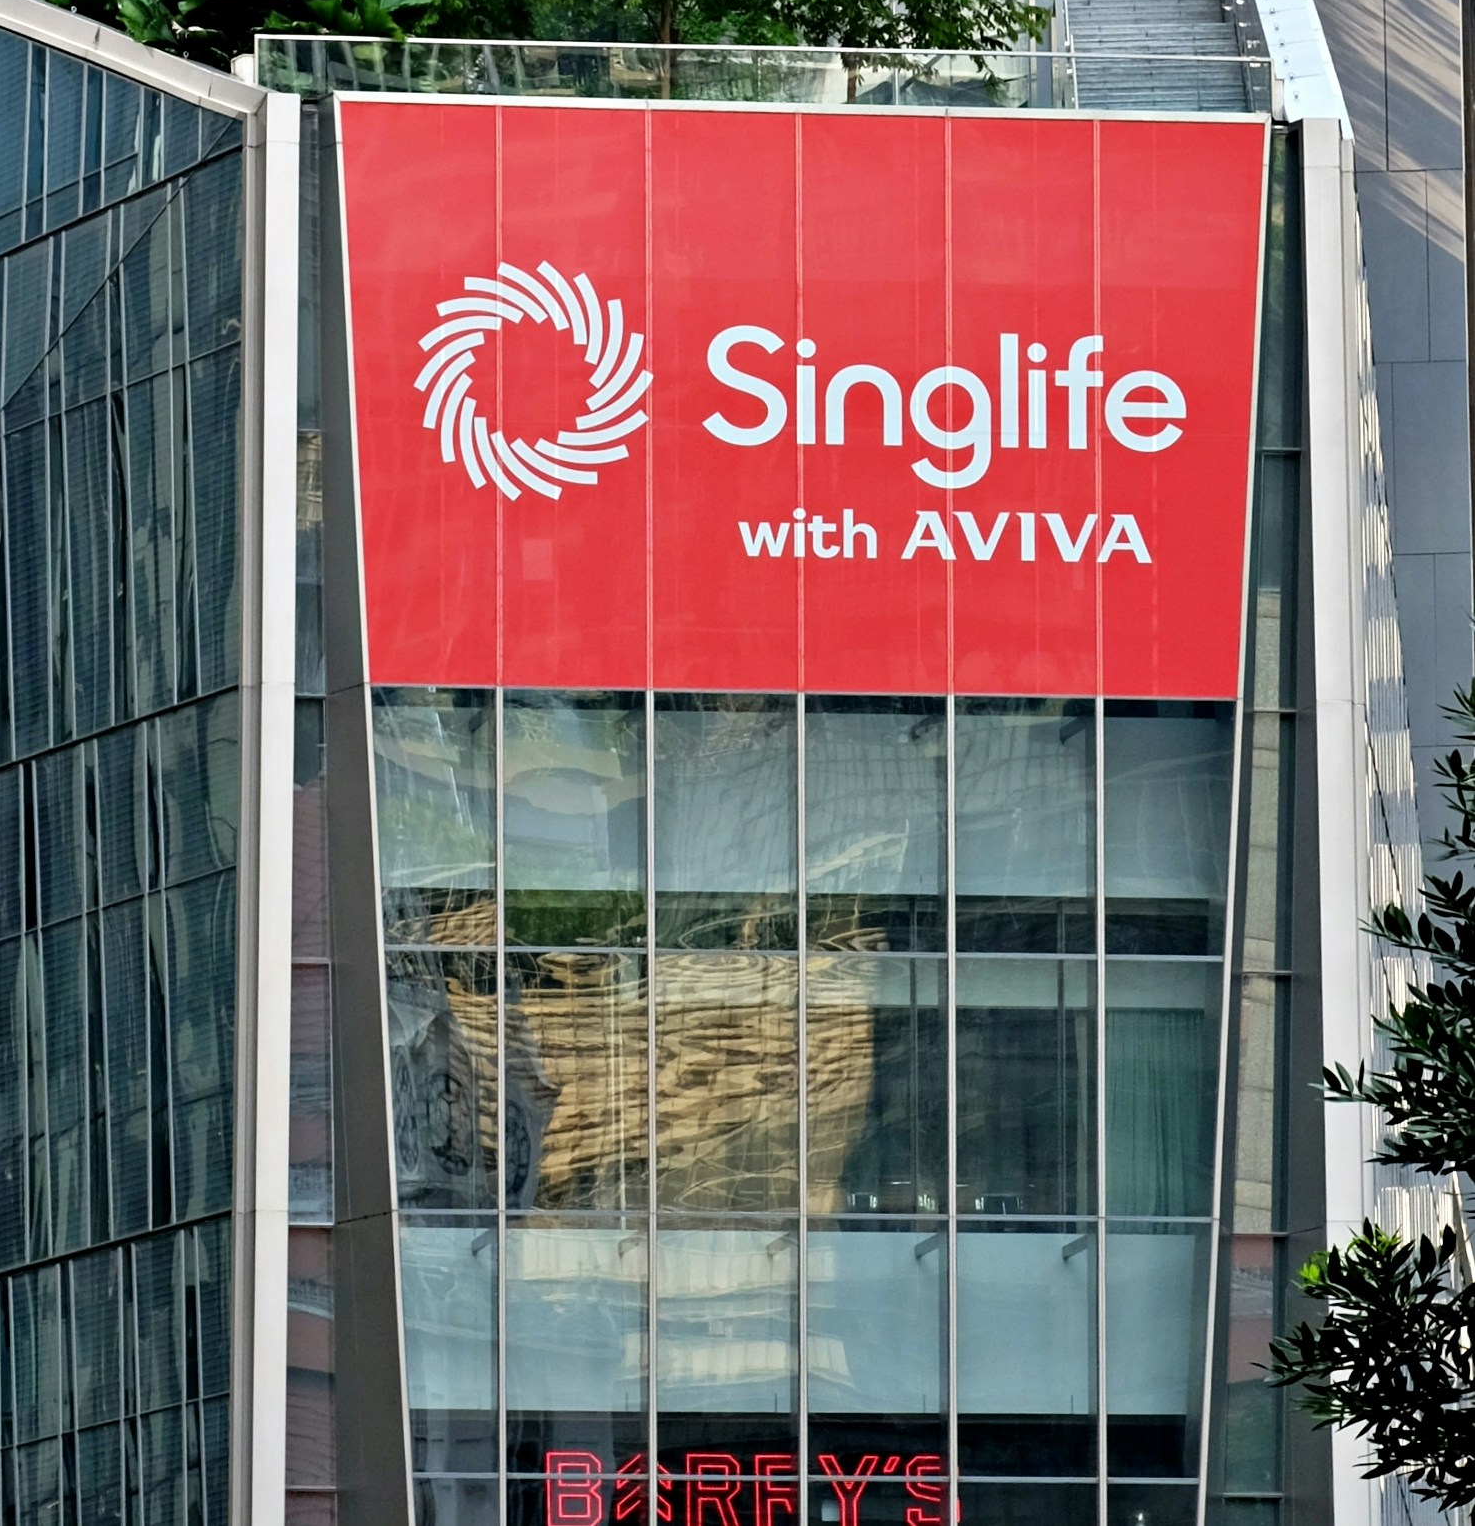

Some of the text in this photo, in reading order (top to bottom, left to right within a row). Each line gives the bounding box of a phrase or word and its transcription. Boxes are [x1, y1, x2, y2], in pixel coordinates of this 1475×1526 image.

[703, 325, 1187, 490] Singlife
[738, 508, 1152, 563] with AVIVA
